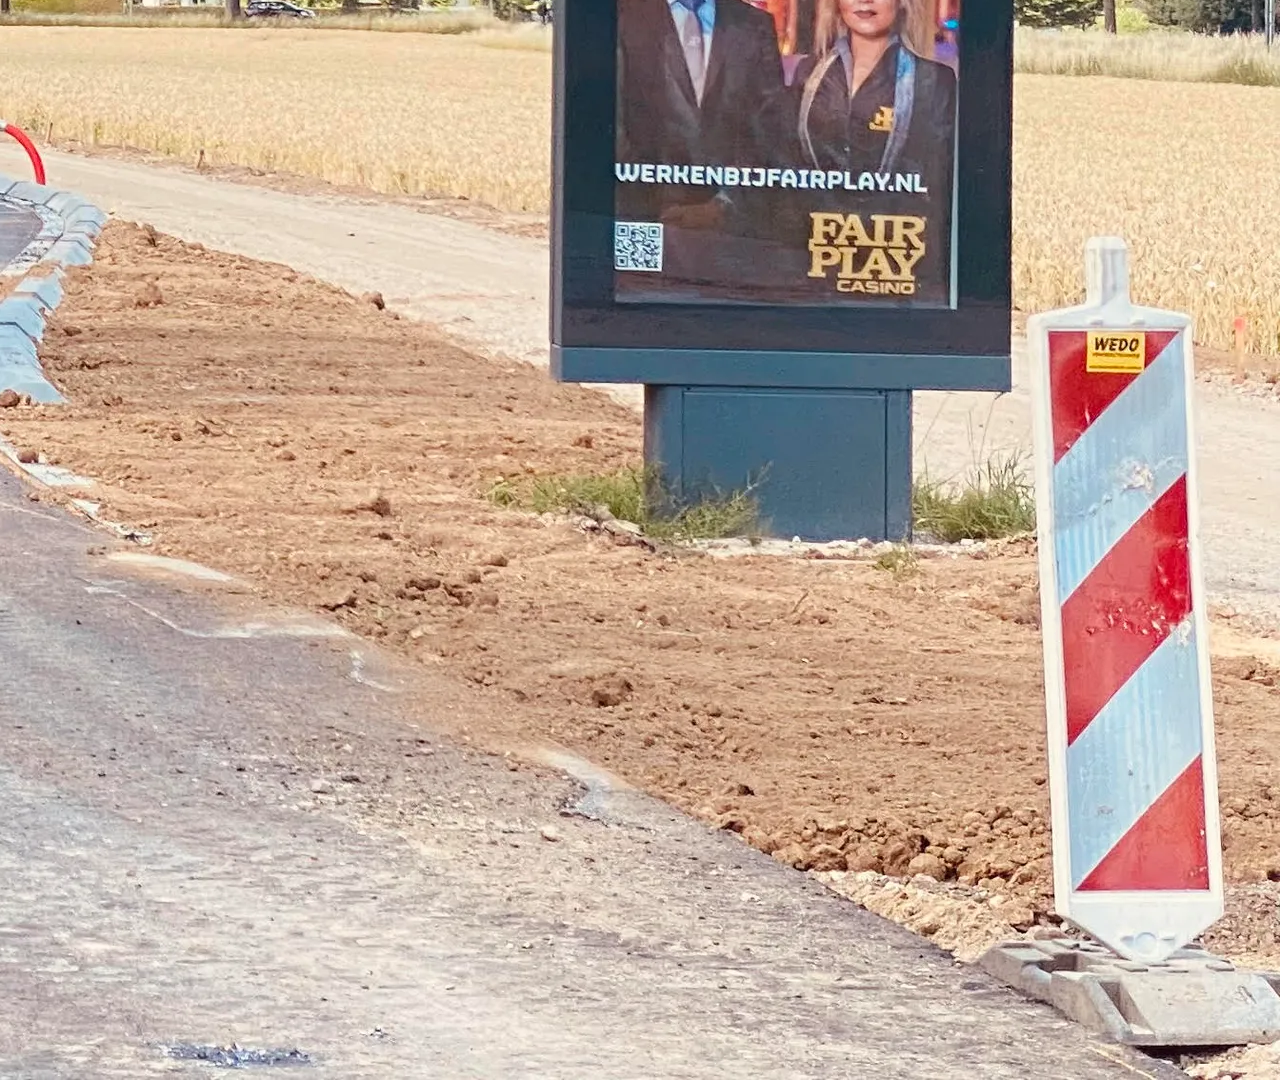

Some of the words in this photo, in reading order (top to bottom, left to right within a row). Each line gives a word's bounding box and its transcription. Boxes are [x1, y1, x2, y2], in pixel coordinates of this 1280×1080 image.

[615, 162, 927, 193] WERKENBIJFAIRPLAY.NL
[809, 212, 927, 248] FAIR
[808, 244, 926, 281] PLAY
[836, 280, 915, 295] CASINO
[1095, 337, 1139, 352] WEDO
